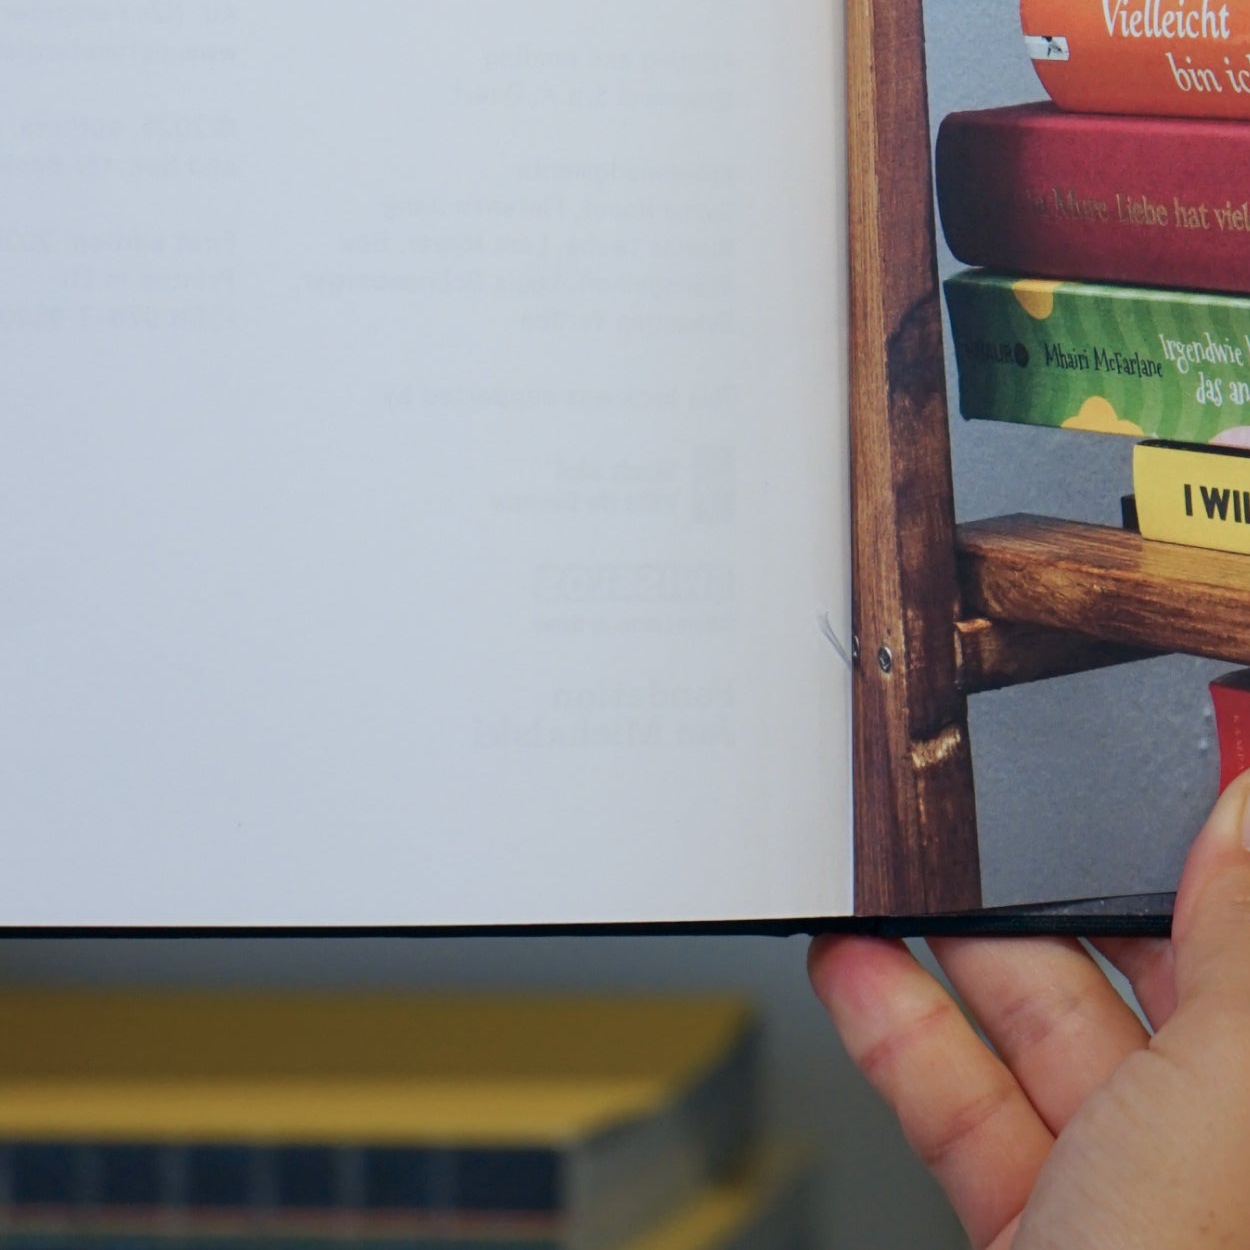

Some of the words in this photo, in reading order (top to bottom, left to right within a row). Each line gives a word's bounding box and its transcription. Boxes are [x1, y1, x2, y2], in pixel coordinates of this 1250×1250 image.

[1165, 52, 1222, 93] bin
[1115, 193, 1169, 227] Liebe
[1173, 197, 1211, 230] hat
[1044, 342, 1090, 371] Mhairi
[1092, 345, 1164, 378] McFarlane
[1158, 332, 1244, 375] Irgendwie
[1196, 371, 1223, 407] das
[1184, 483, 1193, 517] I
